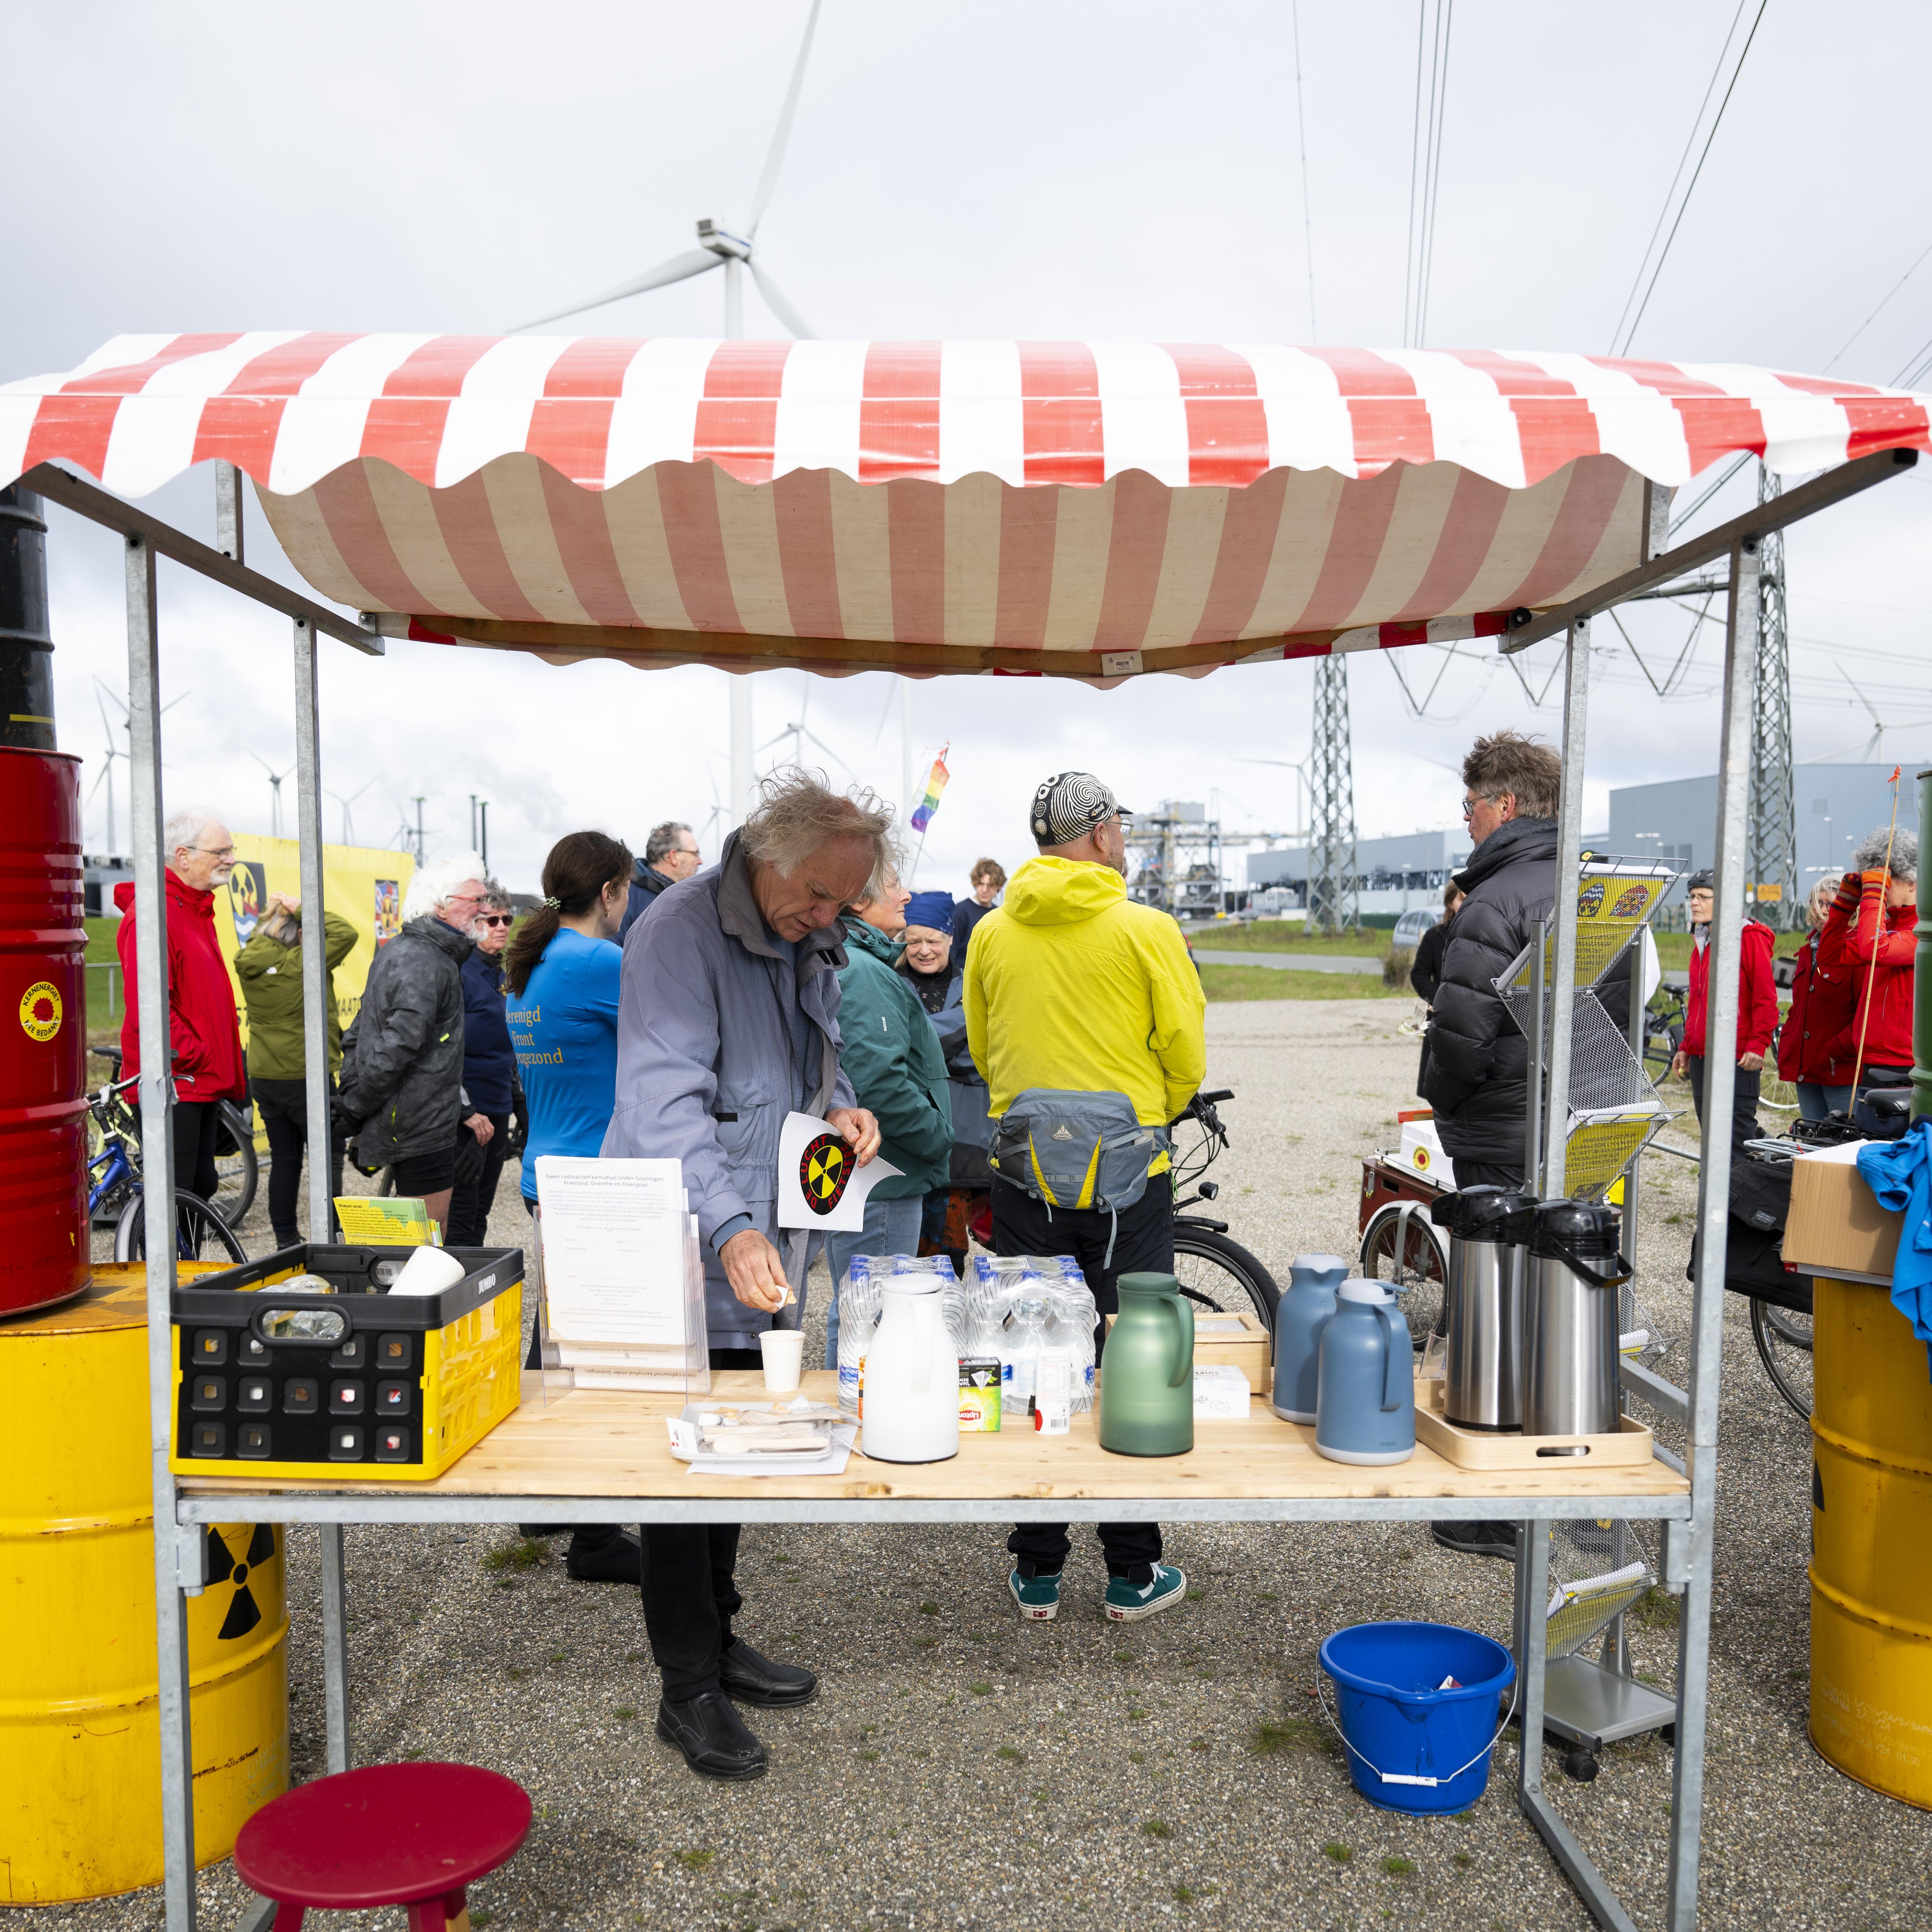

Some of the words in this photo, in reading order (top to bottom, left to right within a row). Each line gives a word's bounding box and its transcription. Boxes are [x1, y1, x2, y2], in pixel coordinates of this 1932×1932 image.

[1090, 802, 1105, 817] cinelli
[23, 984, 59, 1006] KERNENERGIE?
[24, 1019, 36, 1033] NEE
[36, 1015, 60, 1036] BEDANKT
[512, 1031, 535, 1046] Front
[515, 1047, 564, 1068] rngezond
[801, 1135, 828, 1184] LUCHT
[805, 1189, 817, 1210] DE
[478, 1273, 496, 1294] JUMBO
